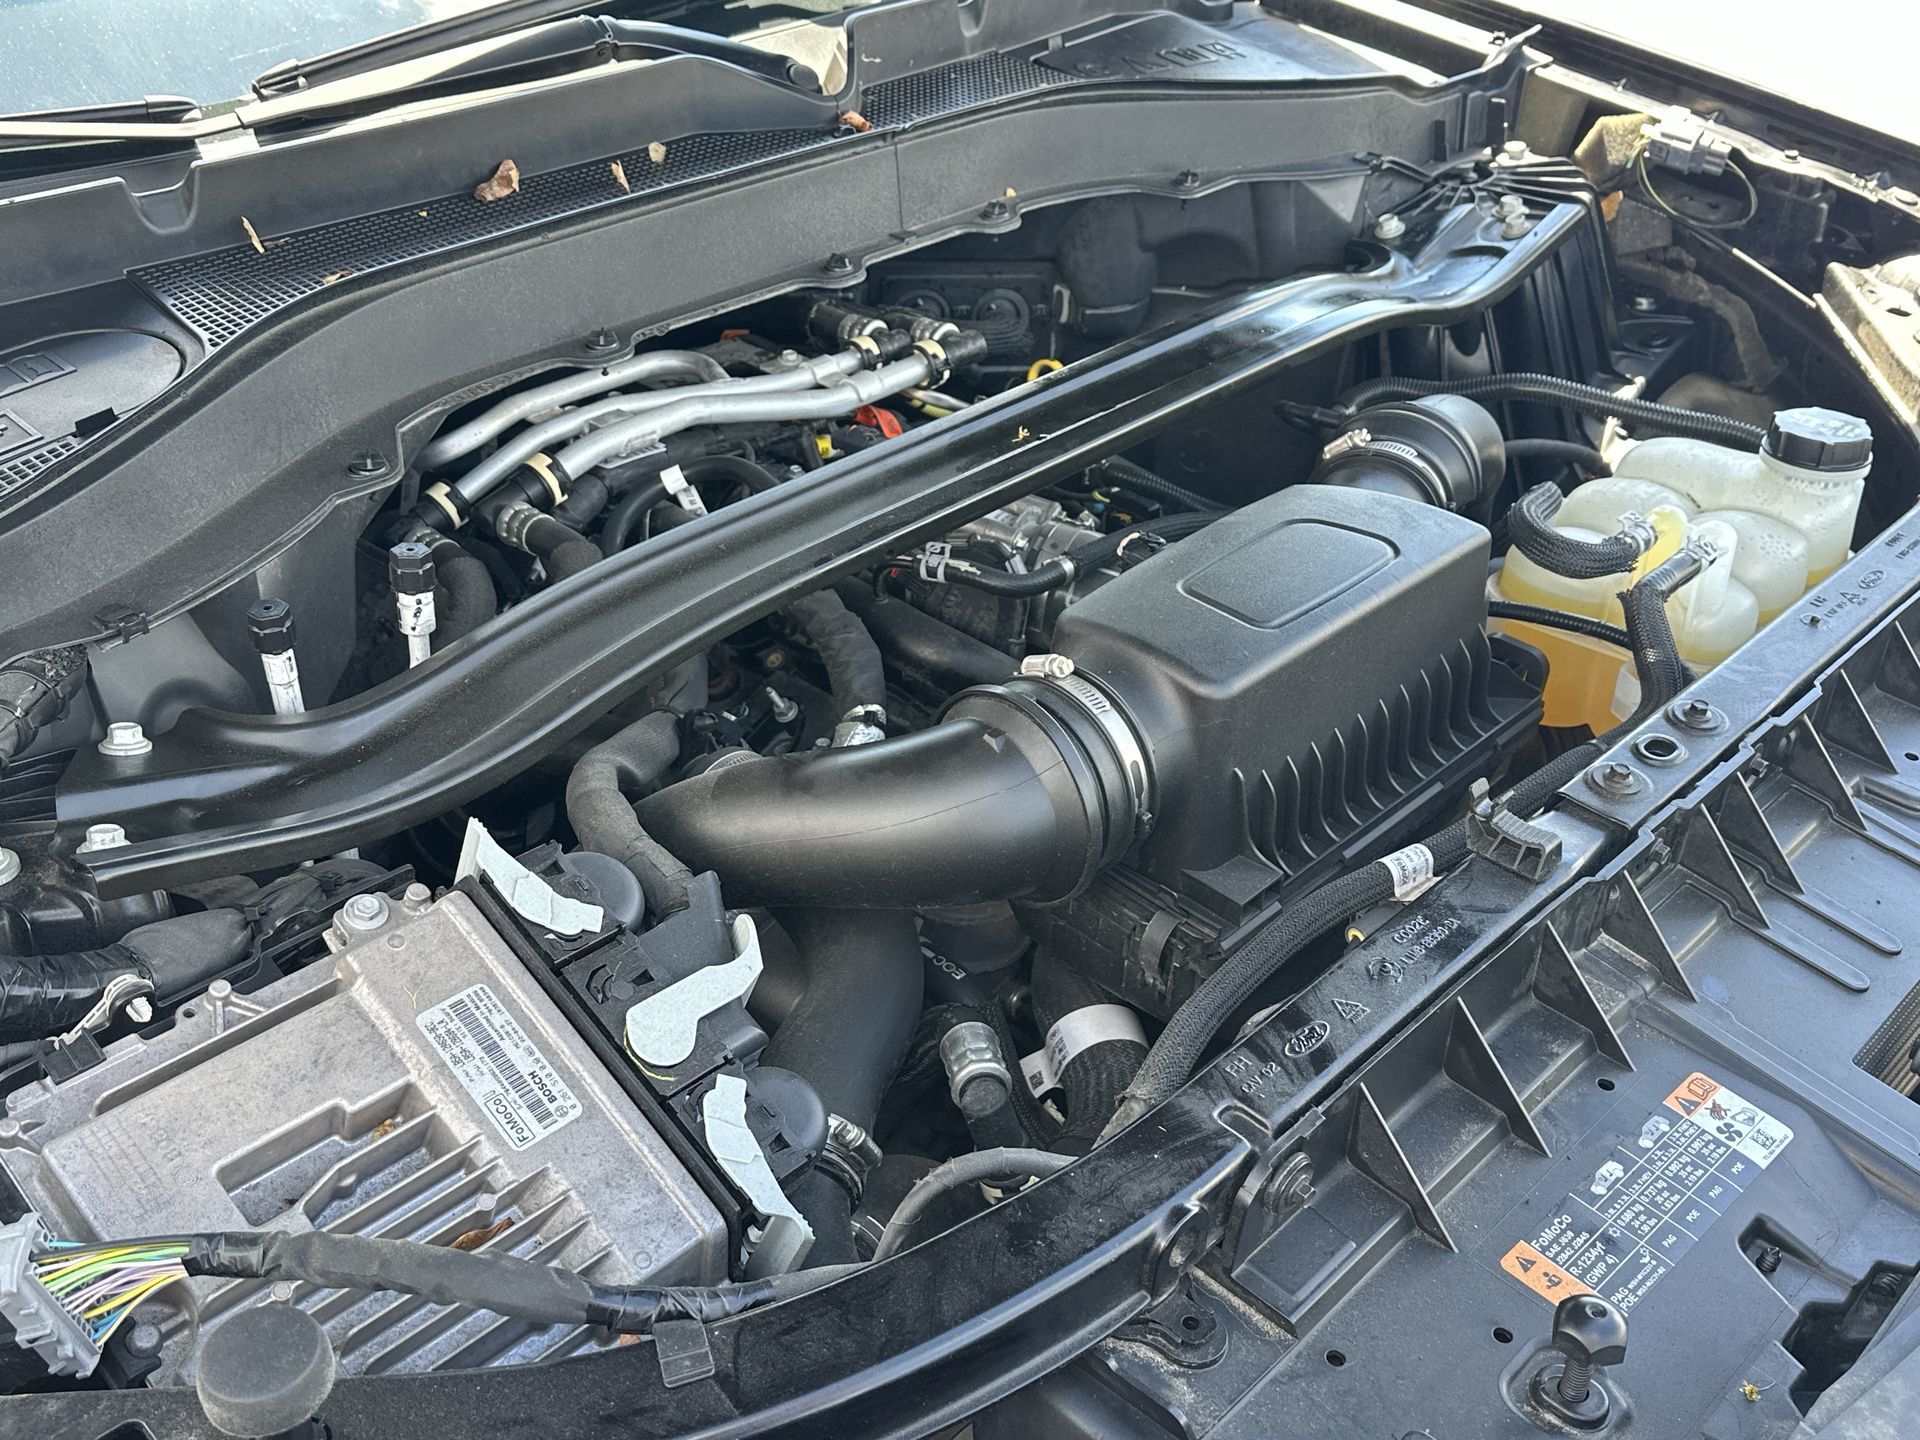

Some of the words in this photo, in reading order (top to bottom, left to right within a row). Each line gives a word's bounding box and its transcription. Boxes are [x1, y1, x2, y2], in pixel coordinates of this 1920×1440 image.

[526, 1069, 558, 1104] BOSCH
[489, 1096, 530, 1143] FoMoCo
[1698, 1130, 1714, 1143] kg
[1676, 1152, 1692, 1165] kg
[1729, 1160, 1746, 1175] POE
[1652, 1177, 1668, 1190] kg
[1707, 1184, 1724, 1199] PAG
[1629, 1201, 1645, 1214] kg
[1684, 1207, 1701, 1223] POE
[1529, 1211, 1573, 1251] FoMoCo
[1544, 1242, 1562, 1258] SAE
[1556, 1229, 1575, 1246] J639
[1660, 1232, 1678, 1248] PAG
[1568, 1240, 1609, 1278] R-1234yf
[1582, 1260, 1612, 1288] (GWP
[1602, 1252, 1620, 1267] 4)
[1609, 1285, 1629, 1304] PAG
[1618, 1292, 1639, 1311] POE
